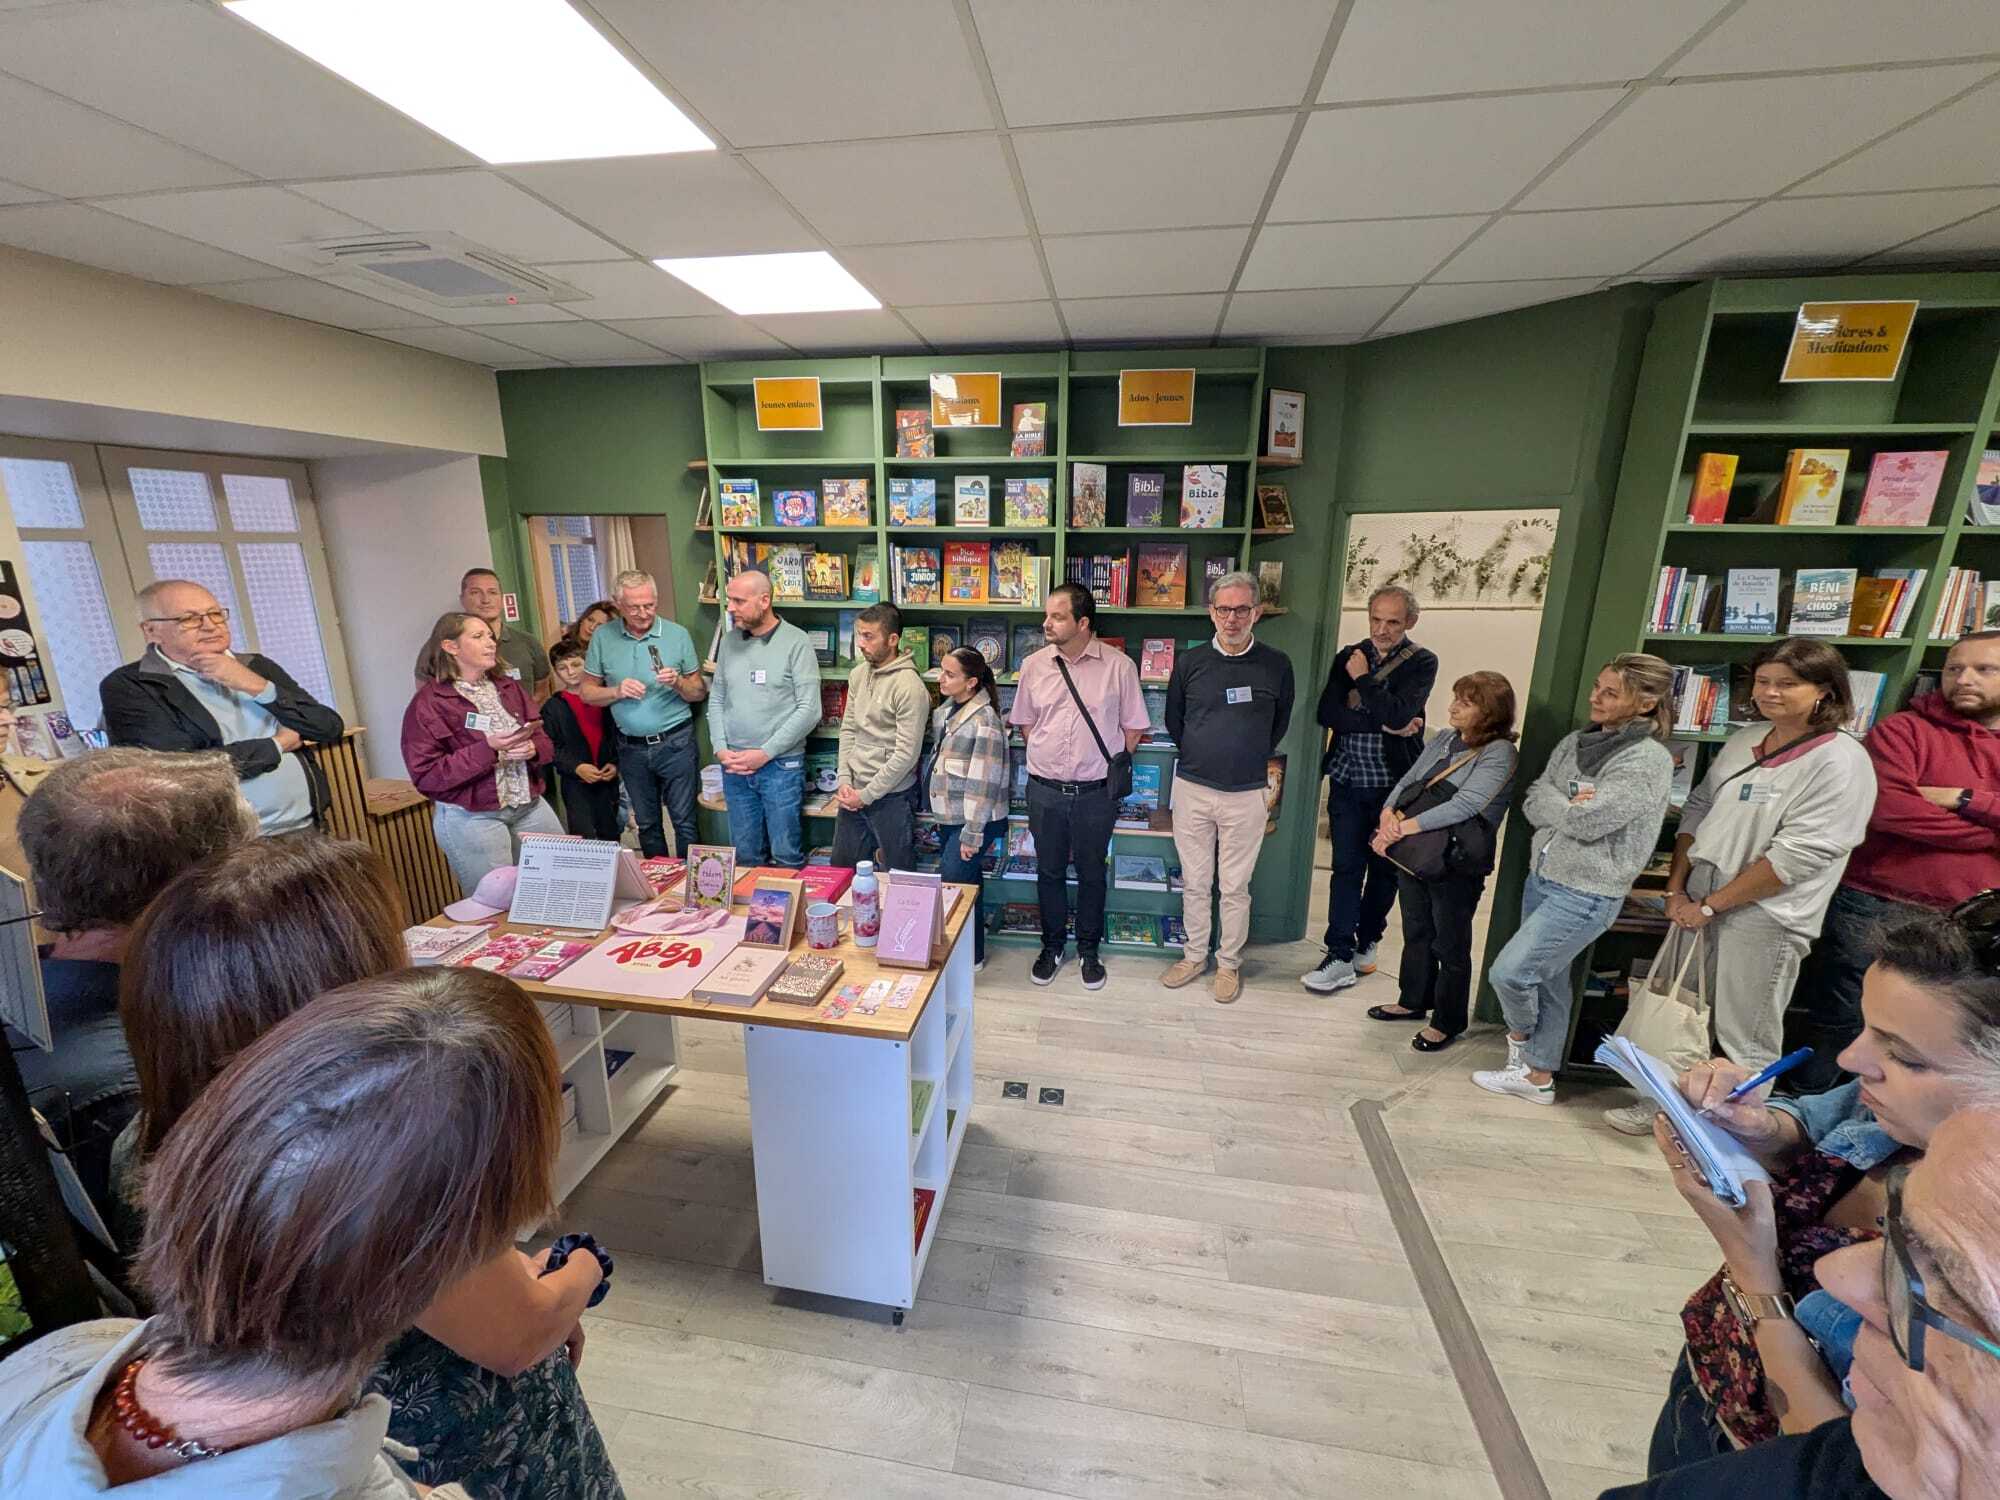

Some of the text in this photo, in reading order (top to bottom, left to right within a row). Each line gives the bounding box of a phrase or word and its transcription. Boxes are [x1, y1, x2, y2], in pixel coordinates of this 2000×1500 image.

[1188, 489, 1219, 498] Bible
[1807, 602, 1838, 611] CHAOS
[606, 941, 703, 969] ABBA
